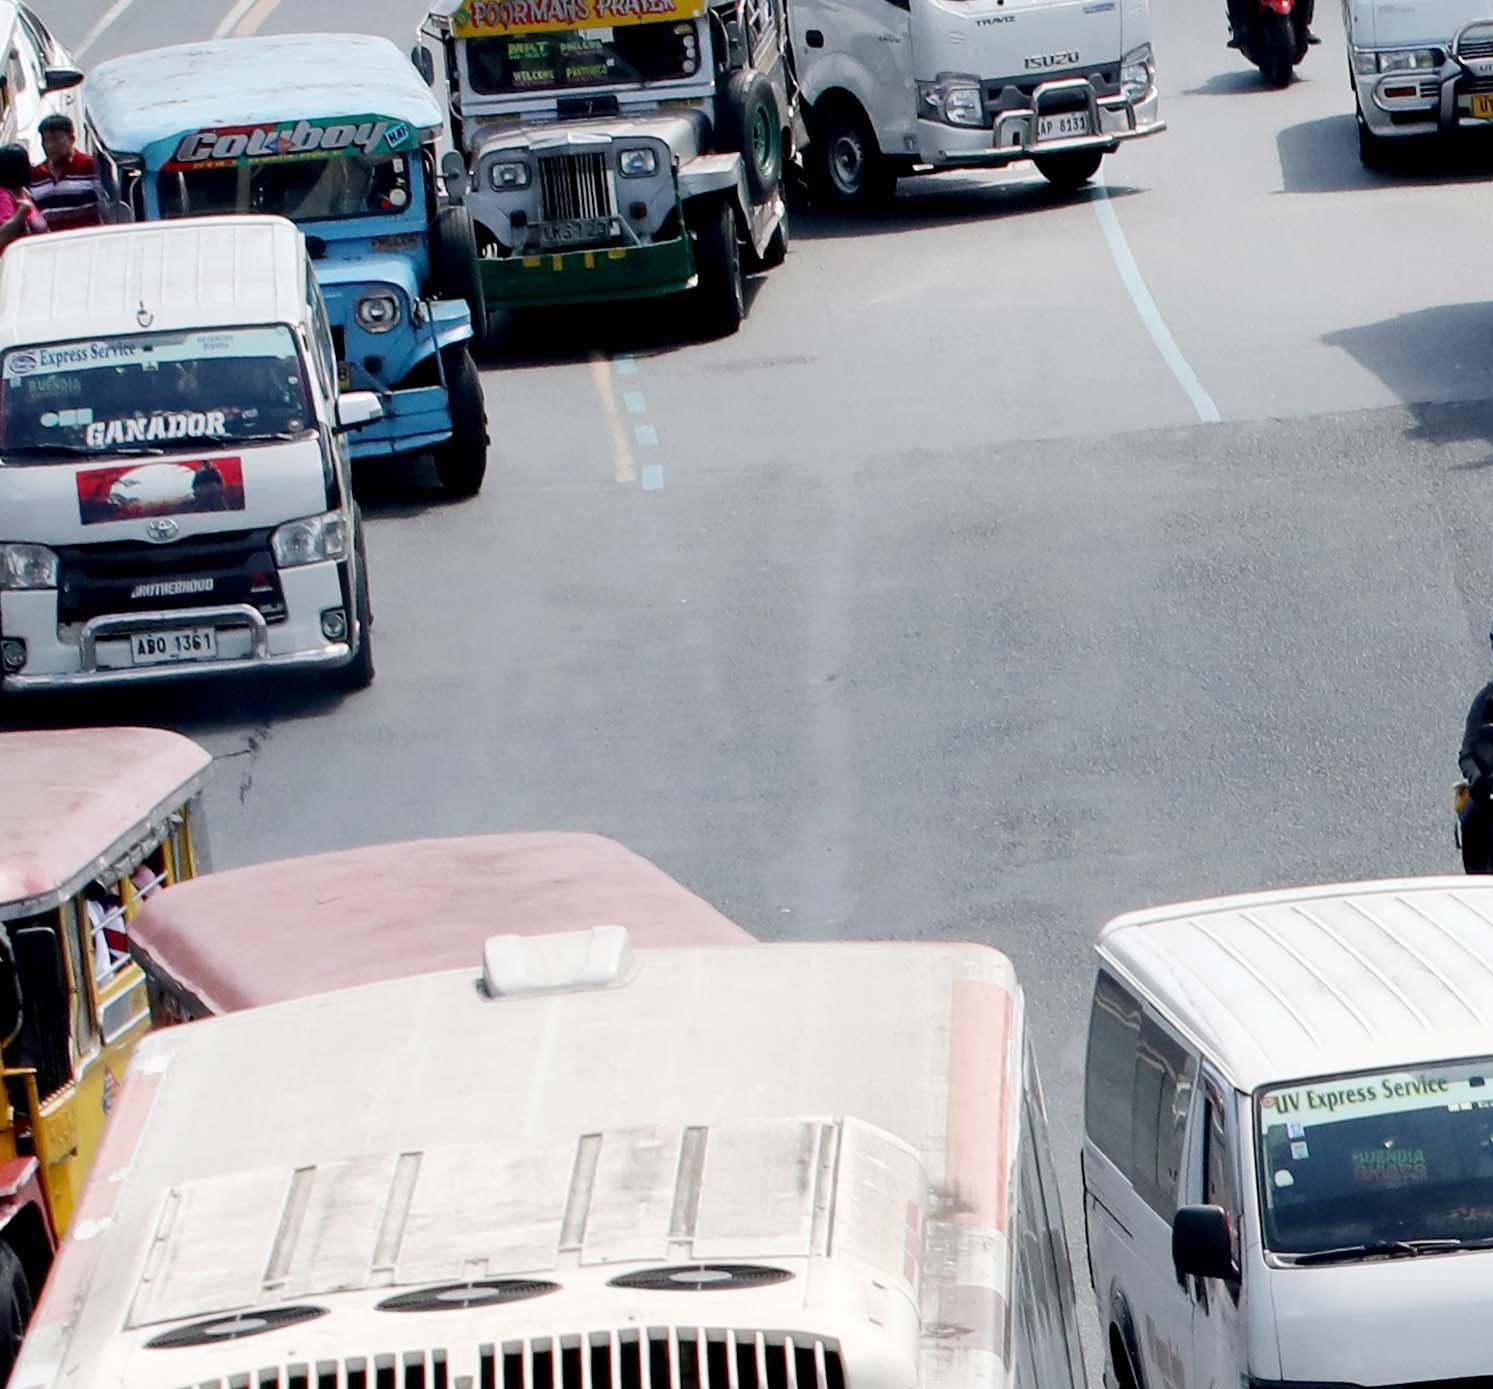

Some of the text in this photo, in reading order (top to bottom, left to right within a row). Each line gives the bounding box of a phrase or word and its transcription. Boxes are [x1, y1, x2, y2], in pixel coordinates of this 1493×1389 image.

[1024, 52, 1080, 70] ISUZU
[1037, 121, 1054, 137] AP
[40, 341, 137, 368] Express Service
[86, 411, 226, 449] GANADOR
[175, 633, 212, 652] 1361
[1275, 1075, 1449, 1116] UV Express Service
